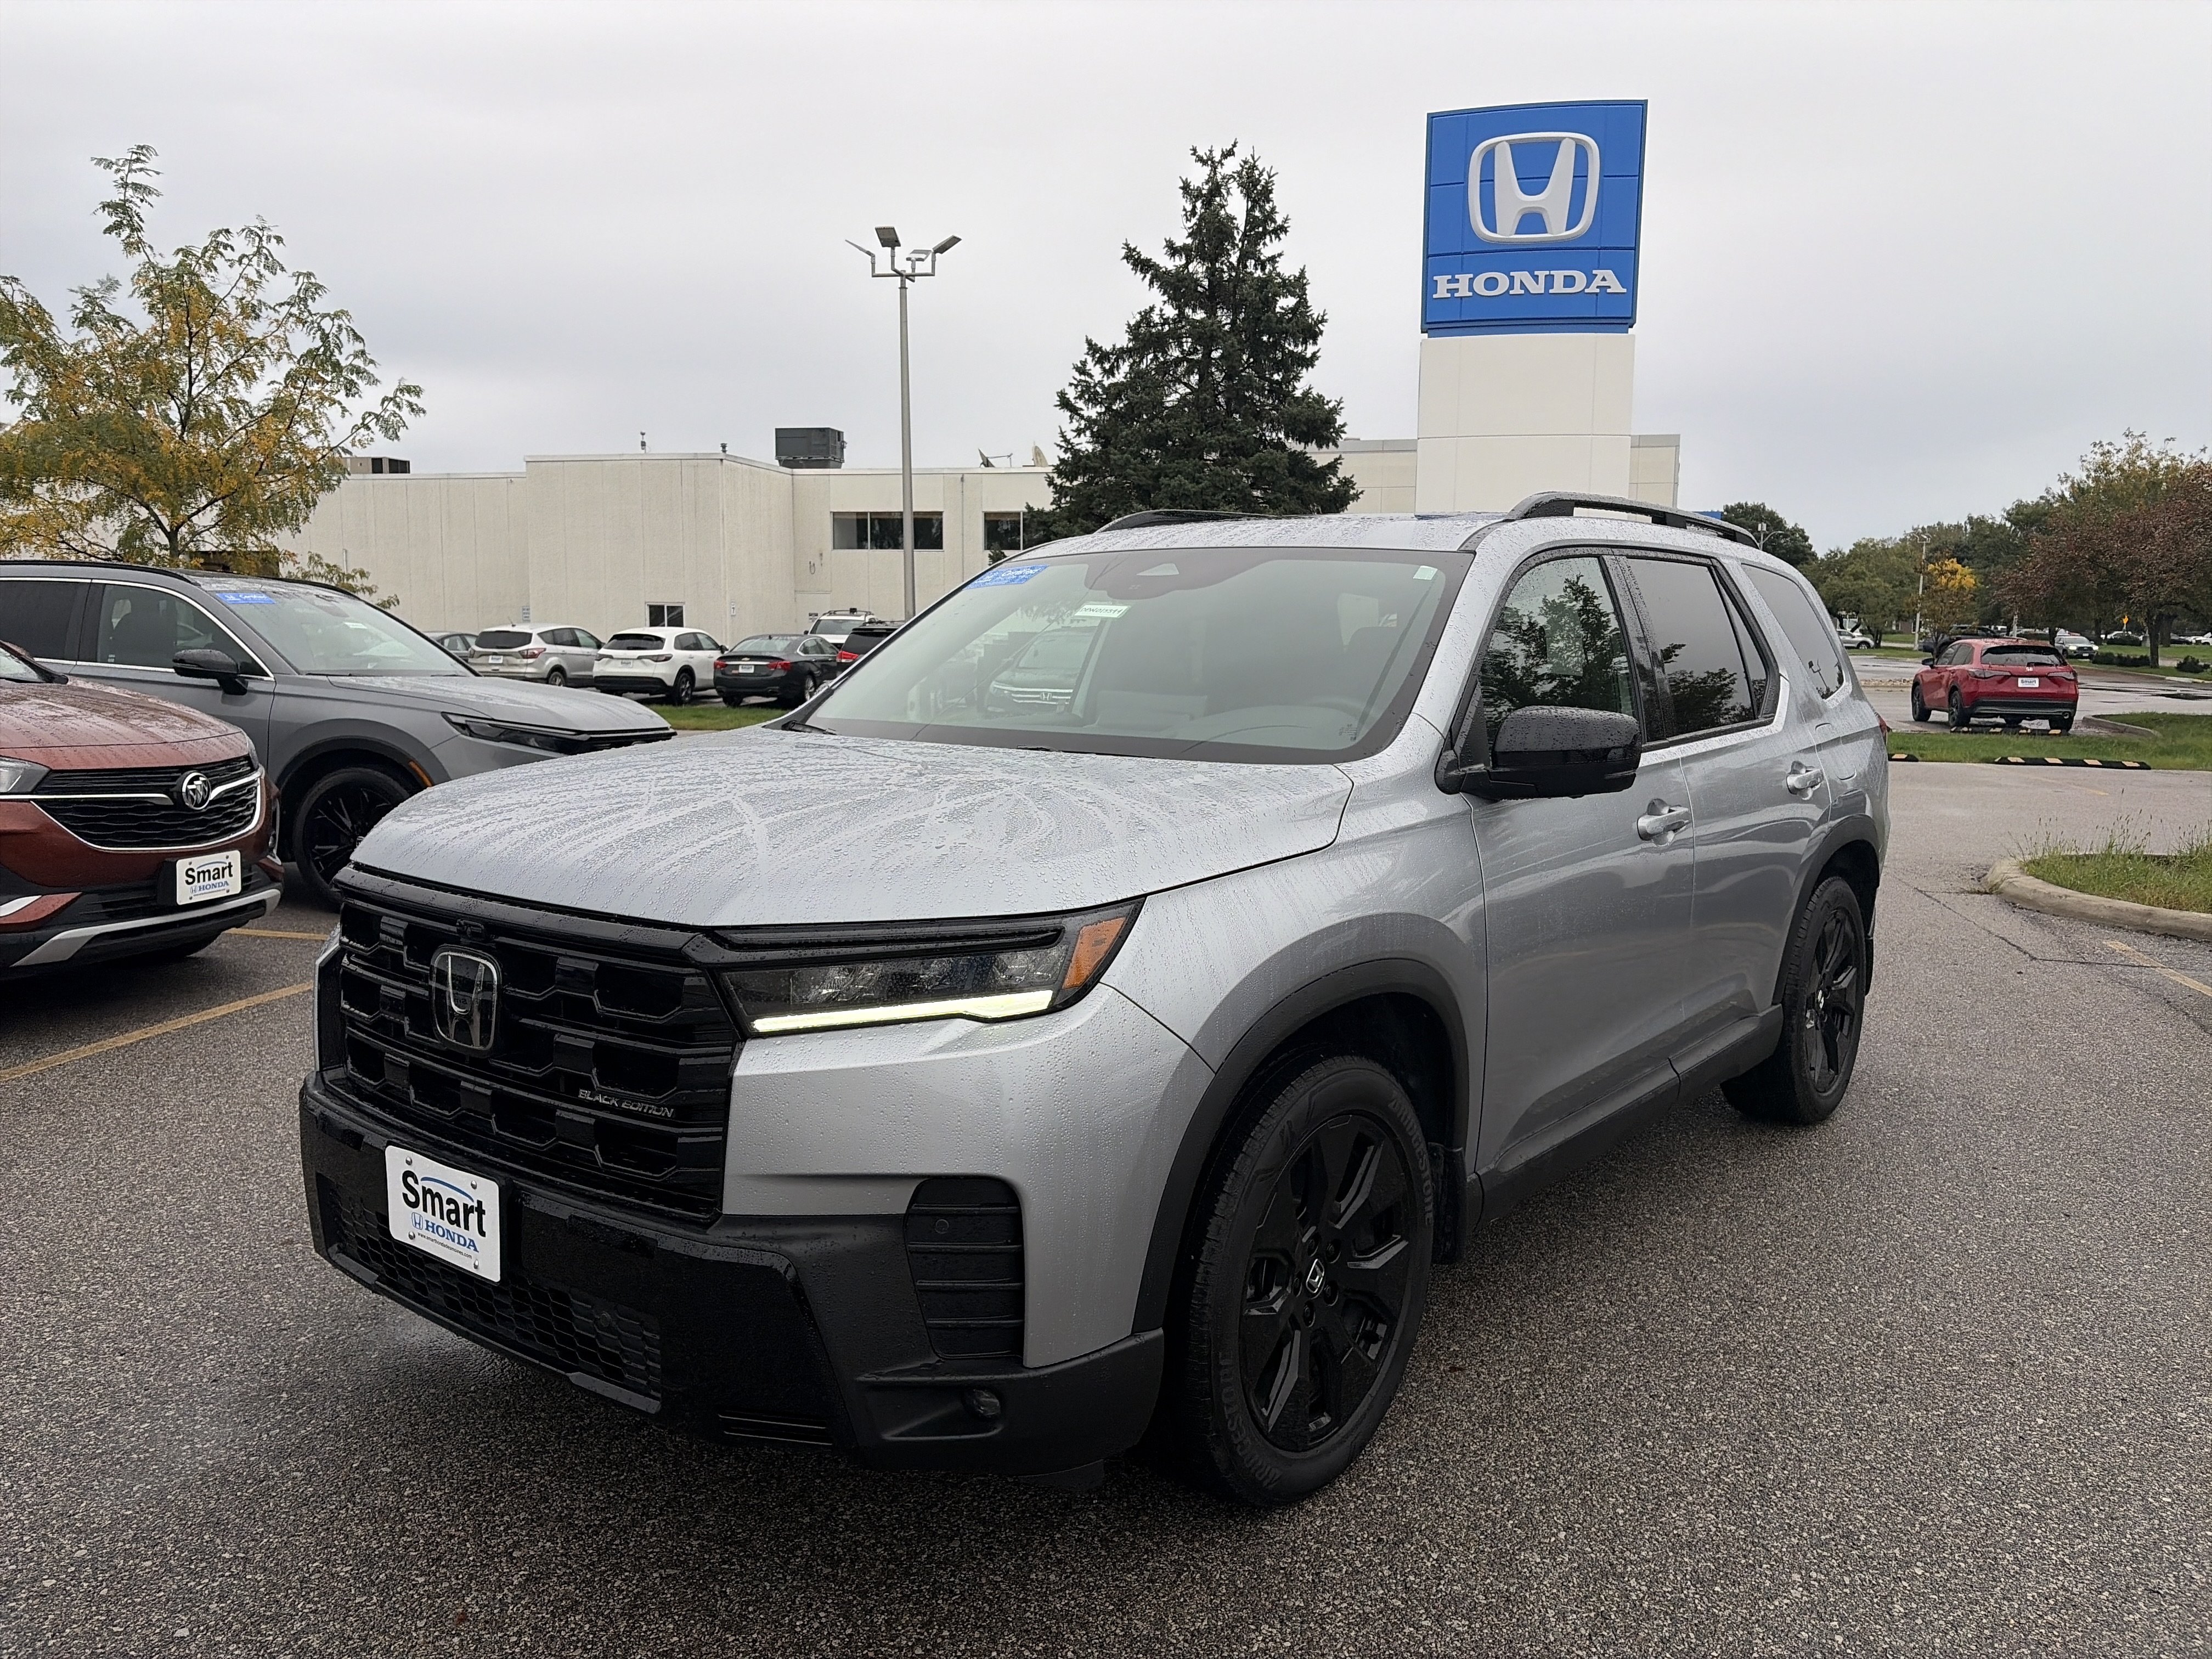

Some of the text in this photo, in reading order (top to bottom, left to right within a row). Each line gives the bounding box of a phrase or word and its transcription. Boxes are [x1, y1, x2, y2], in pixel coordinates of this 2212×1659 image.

[1432, 269, 1627, 299] HONDA
[185, 862, 233, 885] Smart
[198, 881, 229, 891] HONDA
[578, 1088, 674, 1118] BLACK EDITION
[402, 1170, 486, 1238] Smart
[424, 1219, 479, 1253] HONDA
